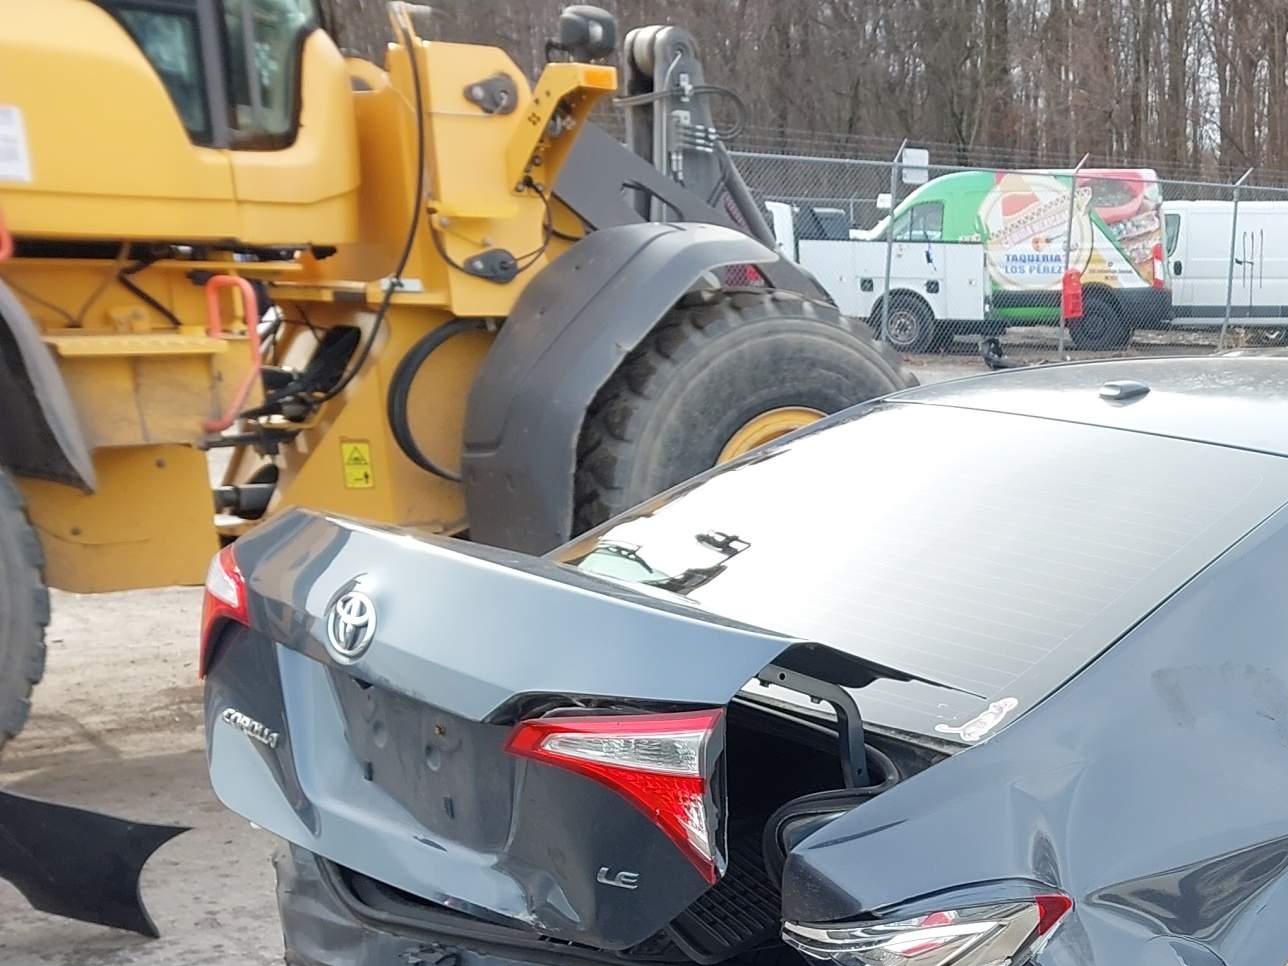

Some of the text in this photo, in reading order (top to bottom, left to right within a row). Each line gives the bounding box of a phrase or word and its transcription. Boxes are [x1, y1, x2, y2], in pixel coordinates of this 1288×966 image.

[1004, 265, 1026, 273] LOS
[222, 707, 280, 749] COROLLA
[596, 866, 640, 890] LE
